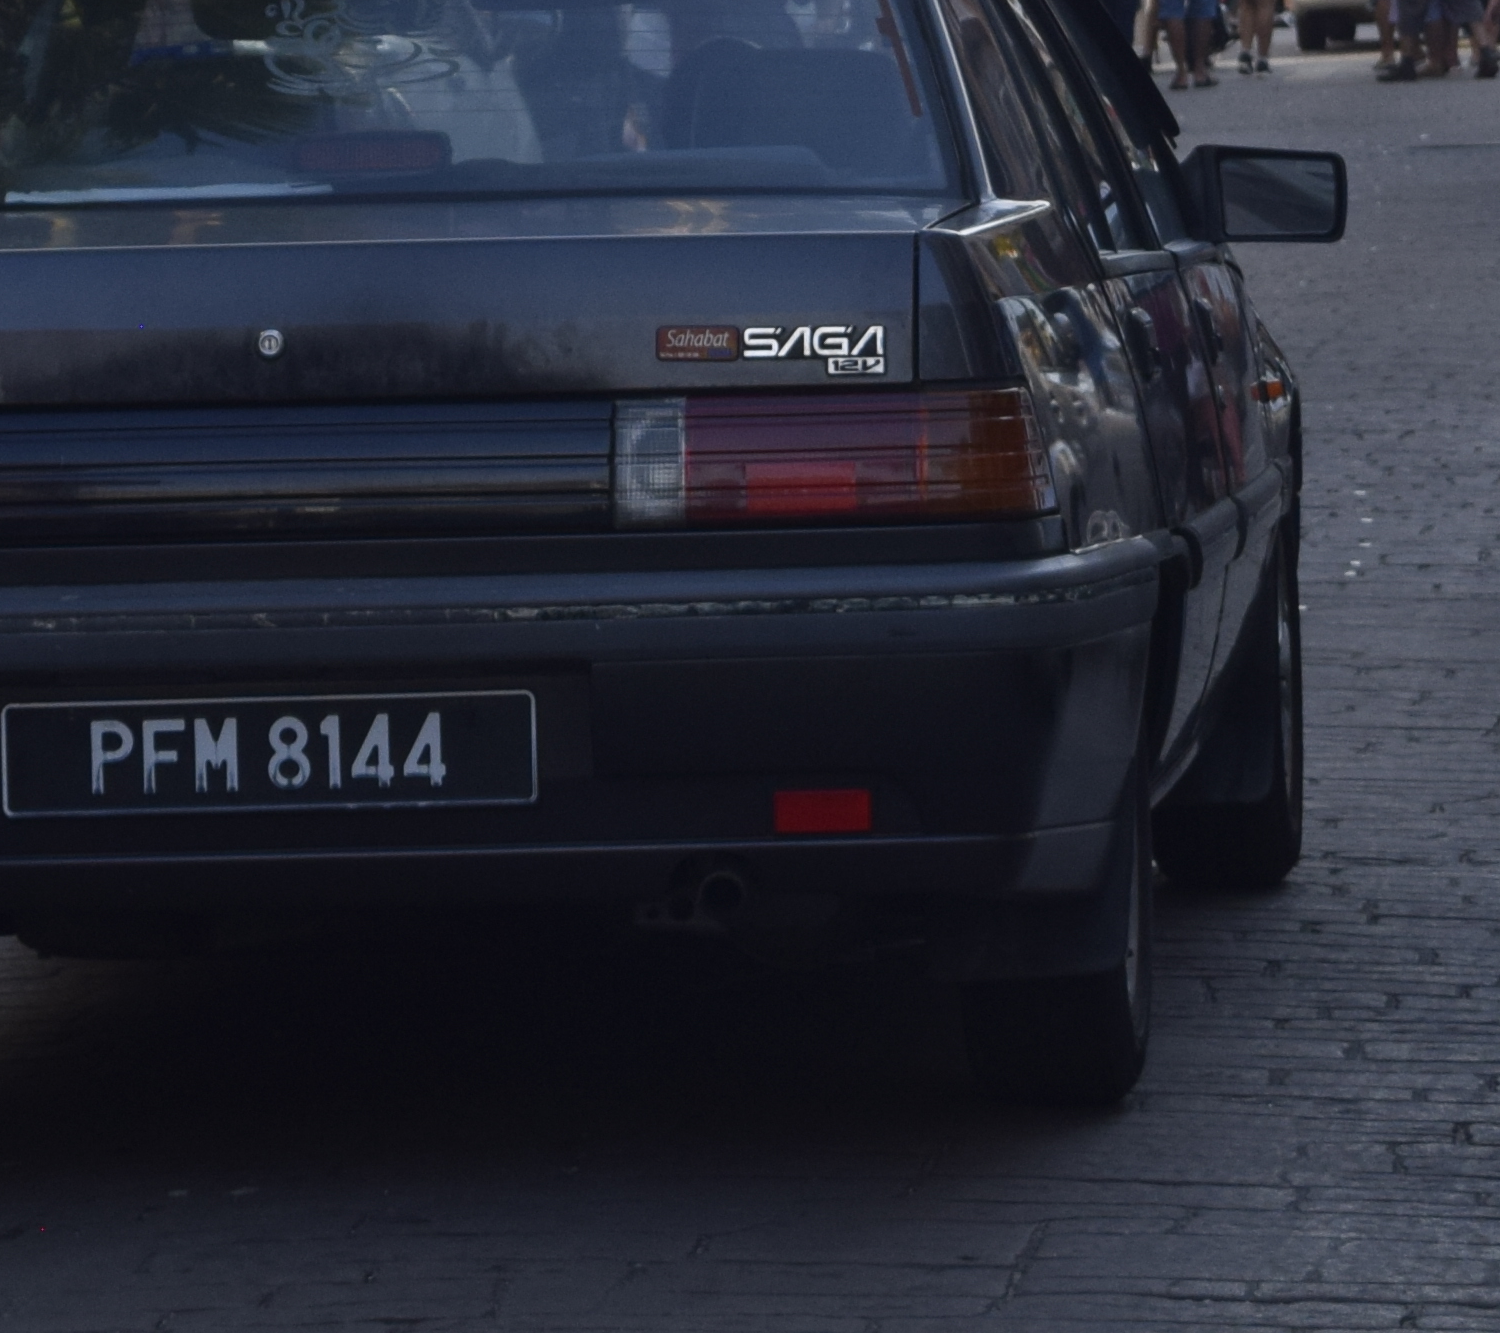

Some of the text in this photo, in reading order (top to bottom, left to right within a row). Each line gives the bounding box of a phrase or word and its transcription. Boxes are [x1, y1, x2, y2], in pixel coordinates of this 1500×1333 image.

[666, 329, 729, 348] Sahabat
[743, 325, 884, 357] SAGA
[831, 358, 881, 372] 12V
[90, 709, 448, 797] PFM 8144
